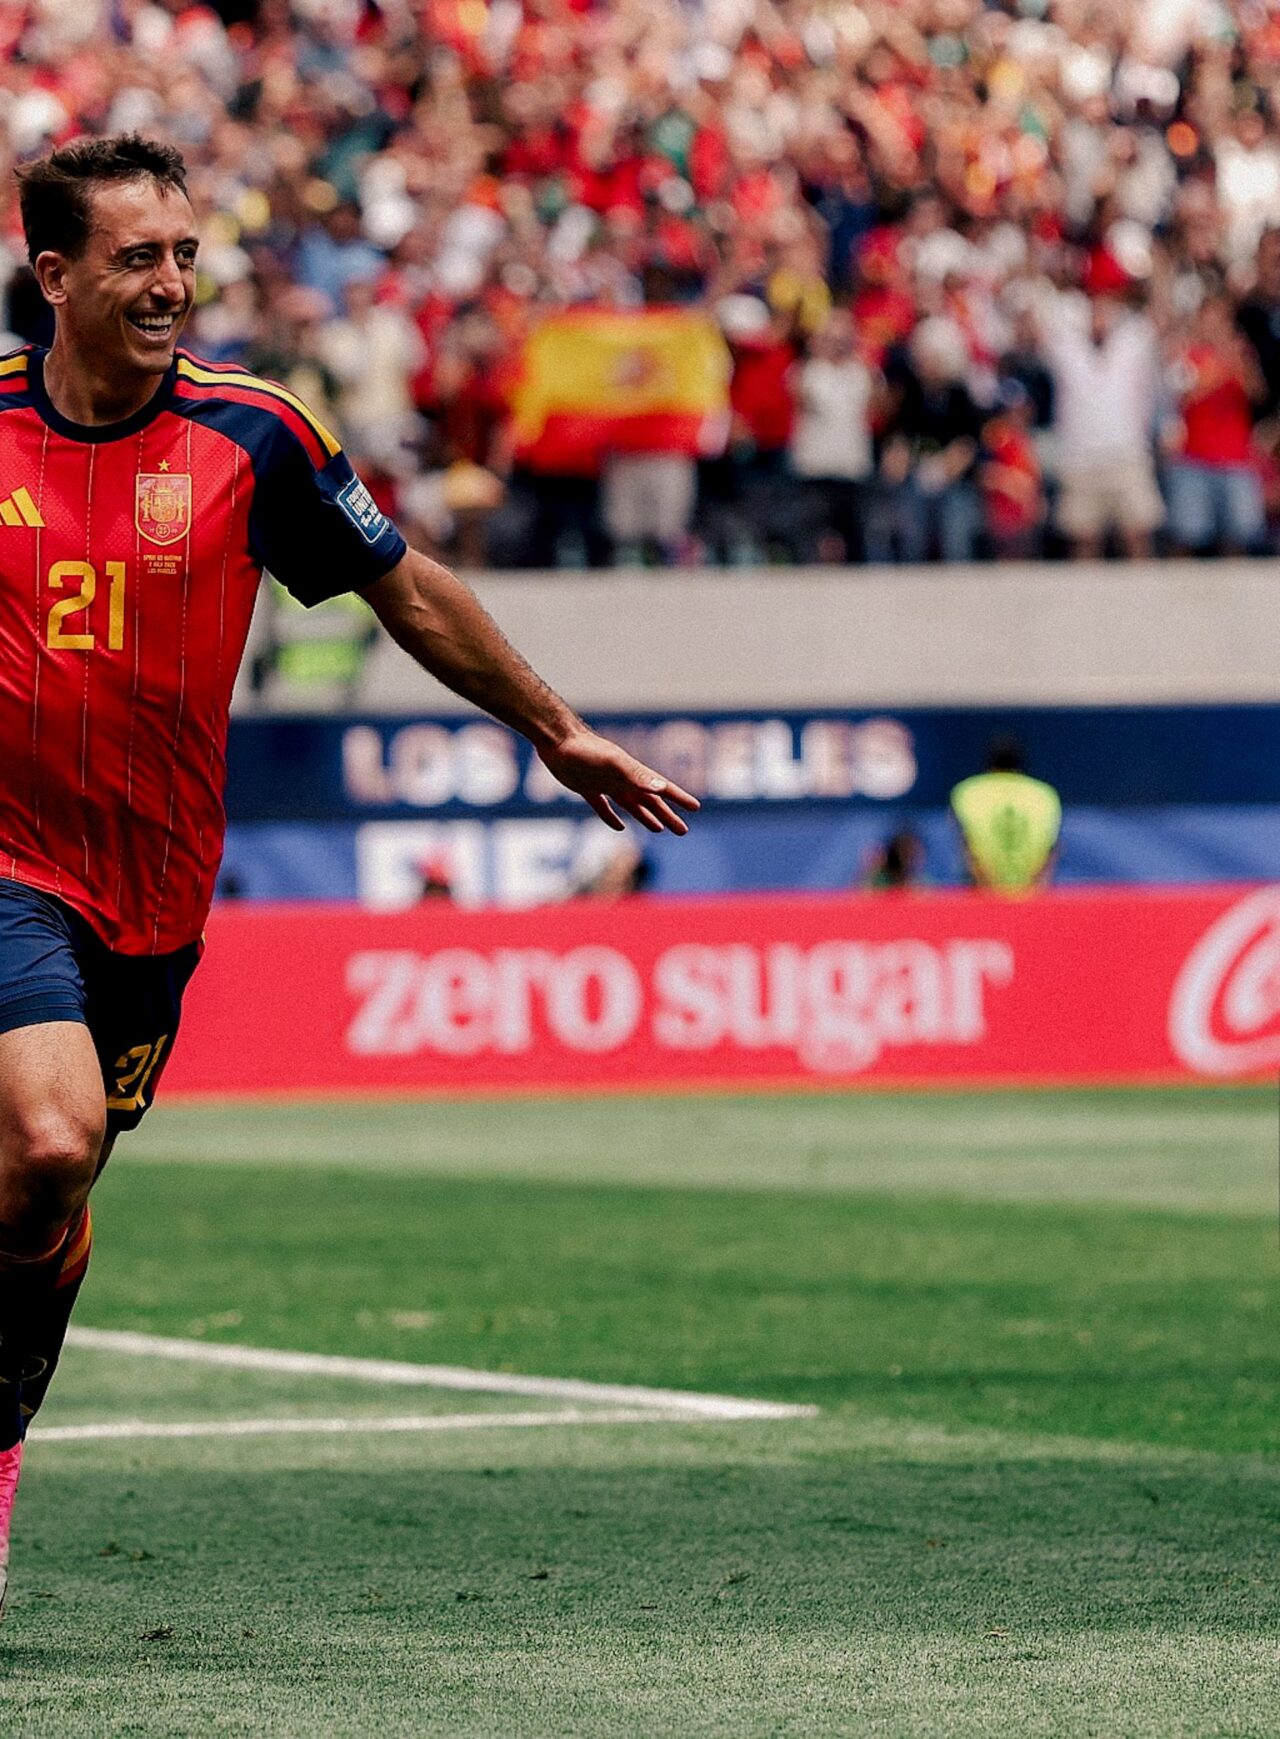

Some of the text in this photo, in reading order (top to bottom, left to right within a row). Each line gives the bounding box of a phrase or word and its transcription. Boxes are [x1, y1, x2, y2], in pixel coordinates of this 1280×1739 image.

[47, 560, 126, 650] 21
[342, 722, 518, 805] LOS
[345, 938, 1014, 1073] zero sugar
[106, 1034, 168, 1111] 21
